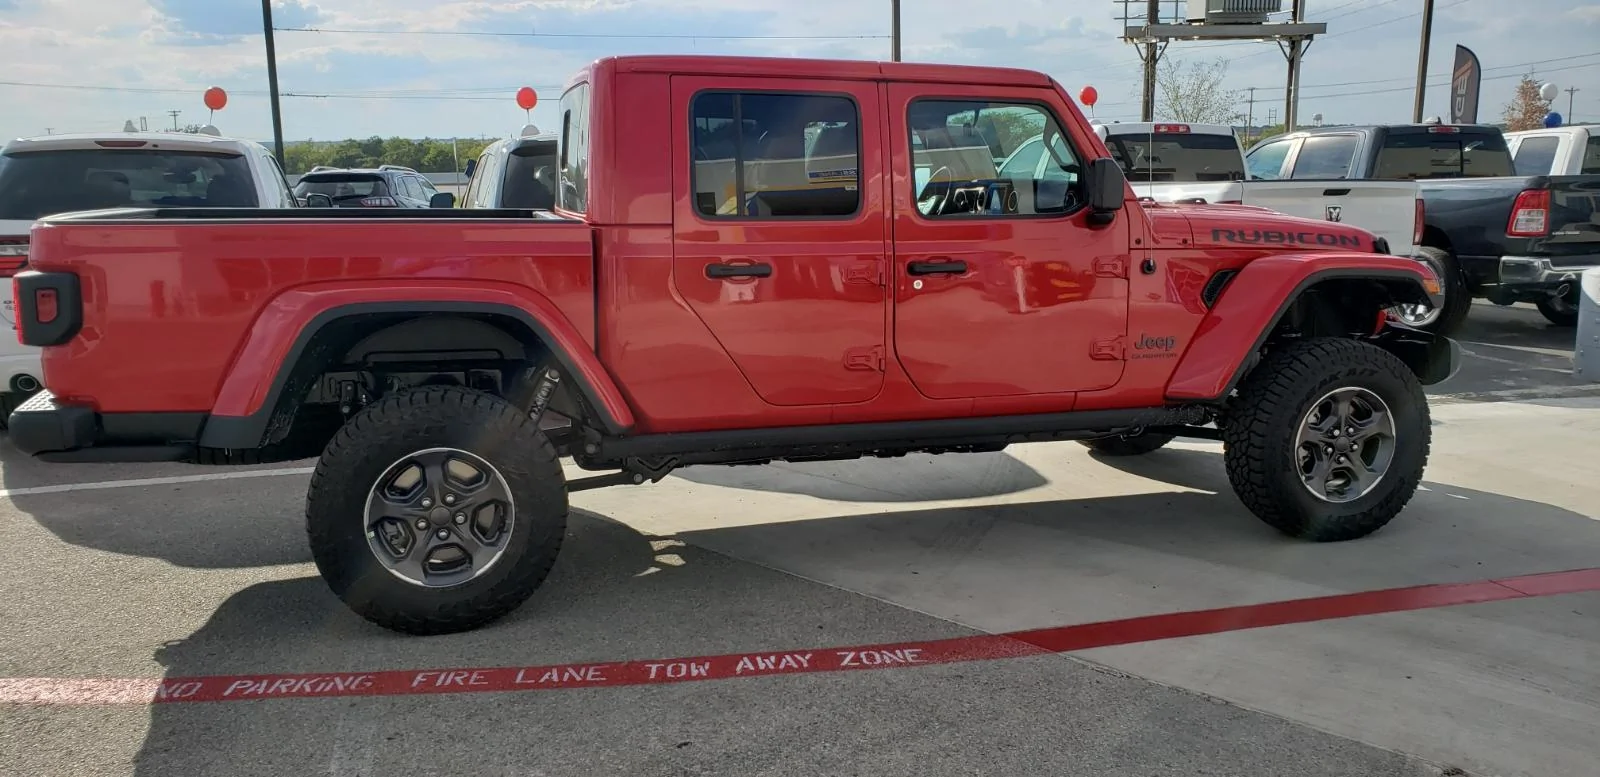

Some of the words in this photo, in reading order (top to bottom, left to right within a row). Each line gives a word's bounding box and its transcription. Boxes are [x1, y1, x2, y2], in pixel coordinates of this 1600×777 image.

[1211, 228, 1361, 246] RUBICON
[1134, 333, 1176, 351] Jeep
[157, 681, 203, 698] NO
[223, 675, 377, 697] PARKING
[411, 670, 489, 688] FIRE
[514, 665, 609, 684] LANE
[644, 660, 711, 681] TOW
[735, 653, 814, 675] AWAY
[836, 648, 925, 667] ZONE
